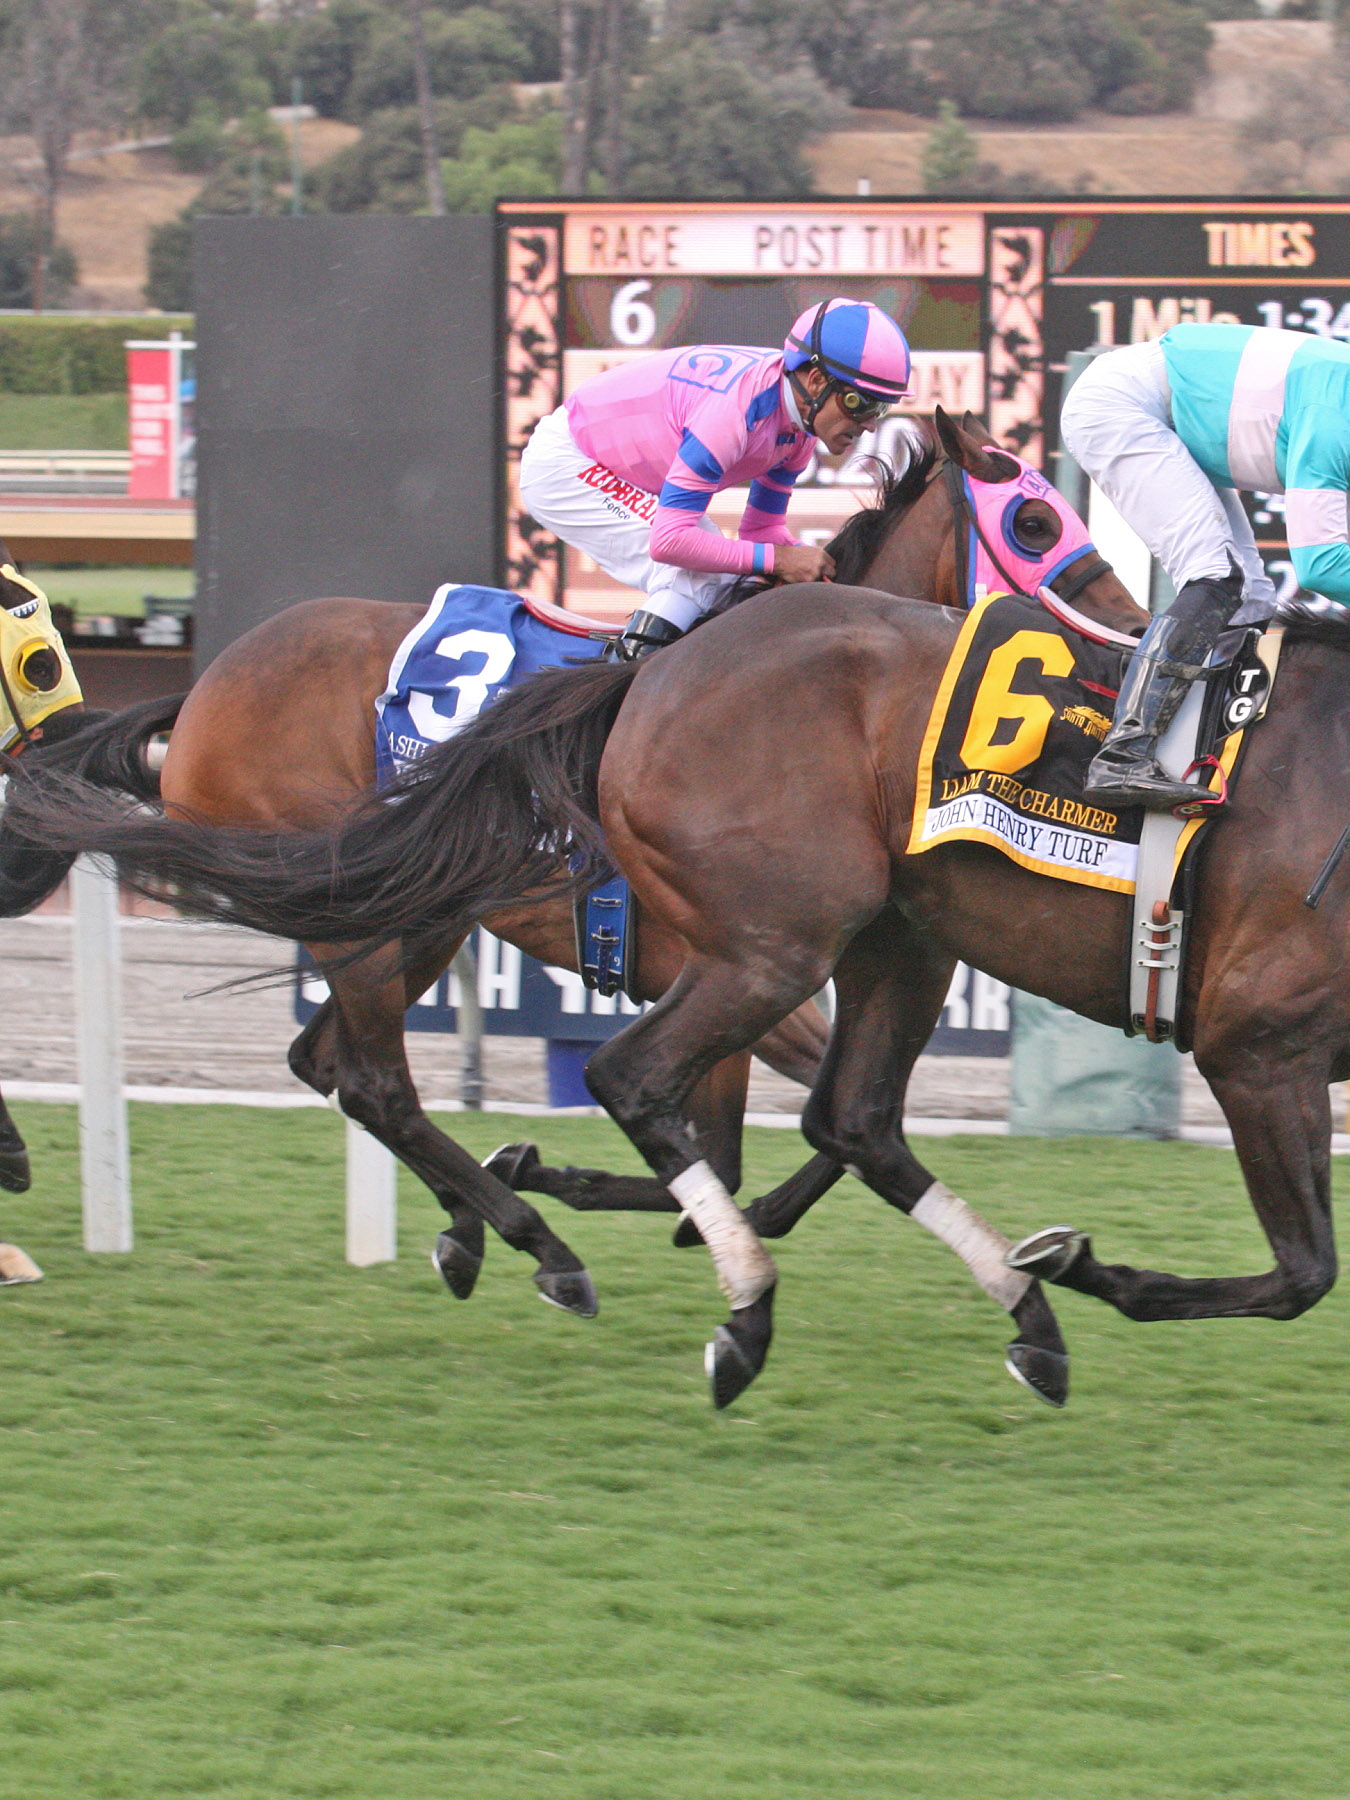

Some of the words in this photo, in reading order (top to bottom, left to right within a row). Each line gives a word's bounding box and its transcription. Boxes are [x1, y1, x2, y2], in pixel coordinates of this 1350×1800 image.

[590, 226, 680, 269] RACE
[754, 225, 841, 269] POST
[865, 226, 952, 269] TIME
[1205, 222, 1316, 267] TIMES
[611, 280, 656, 345] 6
[1089, 301, 1115, 345] 1
[1131, 297, 1241, 343] Mile
[407, 628, 516, 742] 3
[959, 629, 1076, 775] 6
[931, 799, 978, 832] JOHN
[983, 801, 1044, 851] HENRY
[1047, 830, 1109, 867] TURF
[941, 770, 985, 802] LIAM
[986, 773, 1023, 805] THE
[1018, 787, 1118, 834] CHARMER
